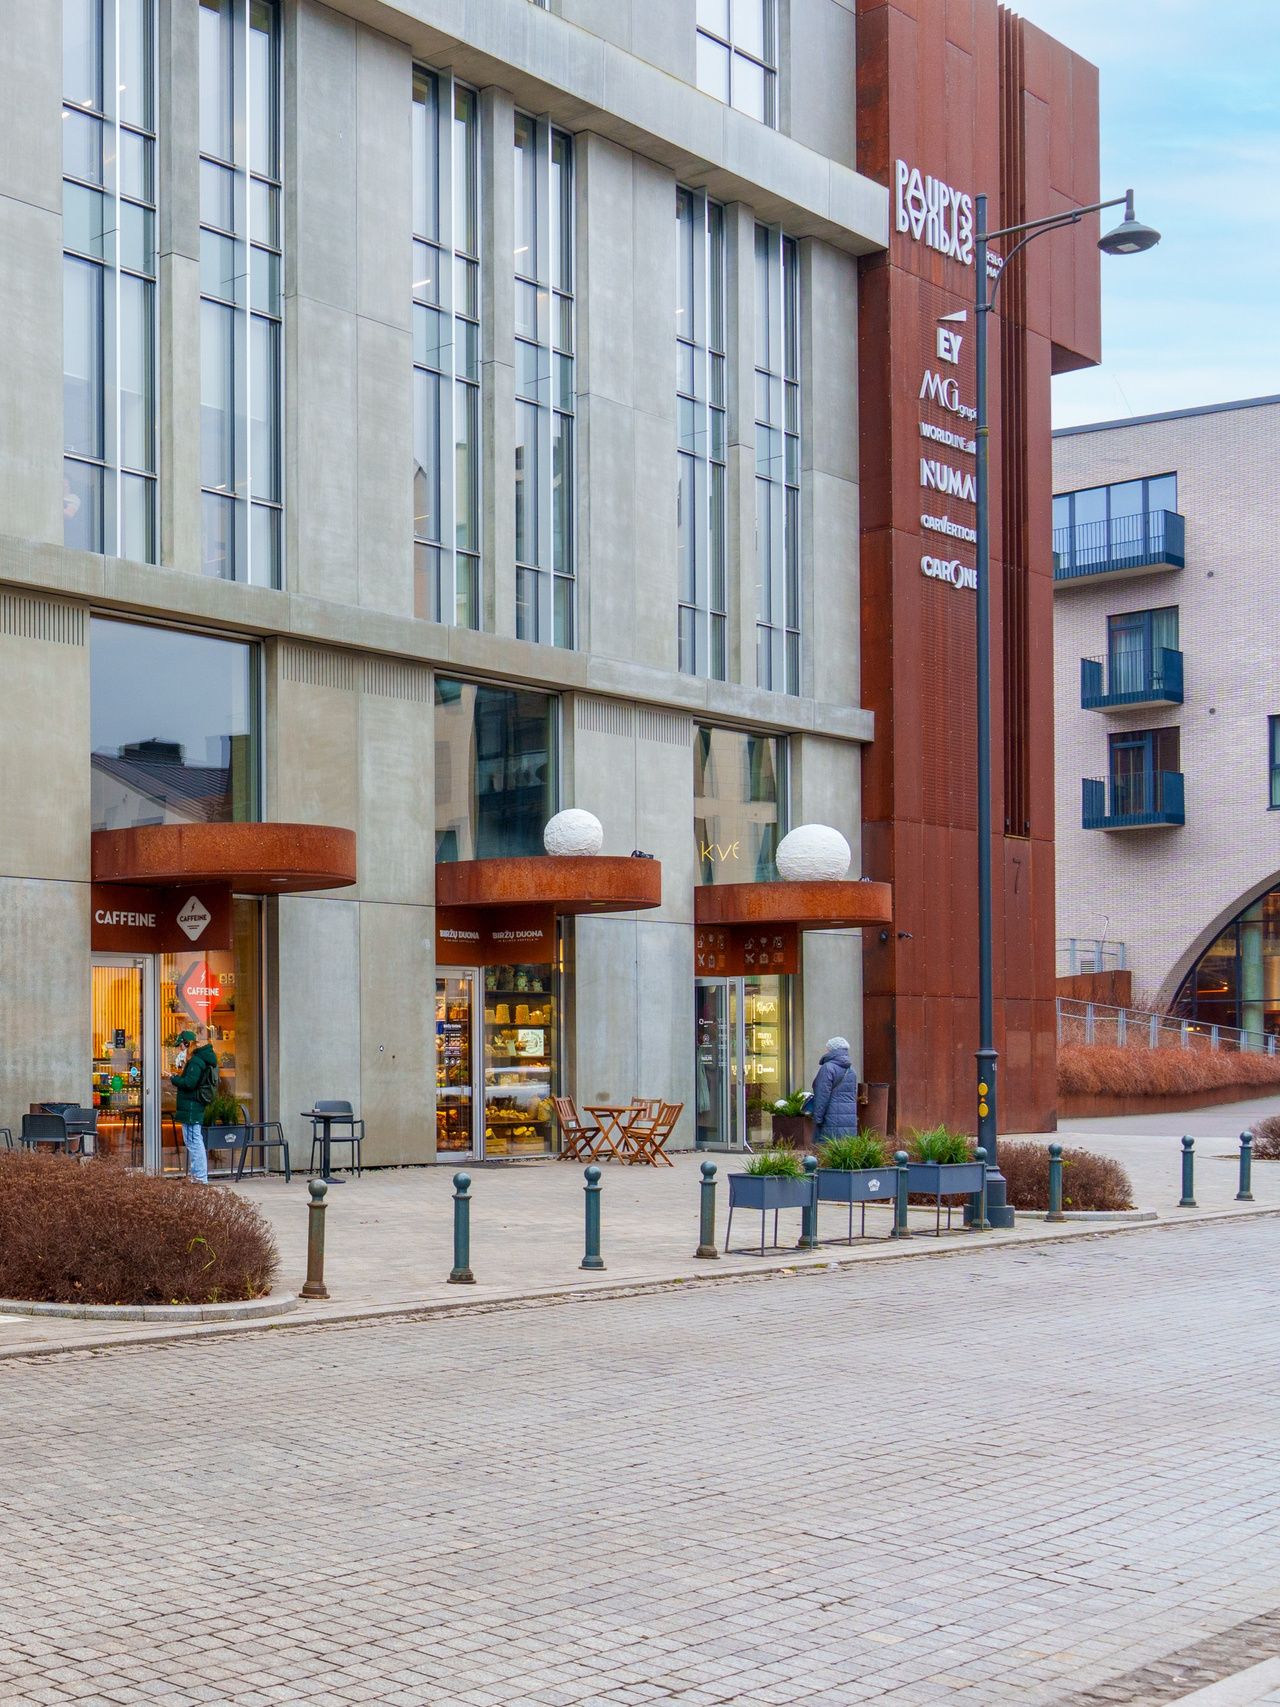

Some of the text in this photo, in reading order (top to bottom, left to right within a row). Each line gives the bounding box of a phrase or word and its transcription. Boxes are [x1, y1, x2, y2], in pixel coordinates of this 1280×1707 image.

[895, 159, 972, 230] PAUPYS
[937, 327, 963, 364] EY
[919, 370, 959, 411] MG
[919, 422, 966, 452] WORLDLINE
[920, 457, 977, 503] NUMA
[920, 514, 977, 543] CARVERTICA
[95, 910, 156, 927] CAFFEINE
[180, 914, 207, 922] CAFFEINE
[458, 931, 479, 939] DUONA
[515, 930, 543, 938] DUONA
[186, 987, 220, 996] CAFFEINE
